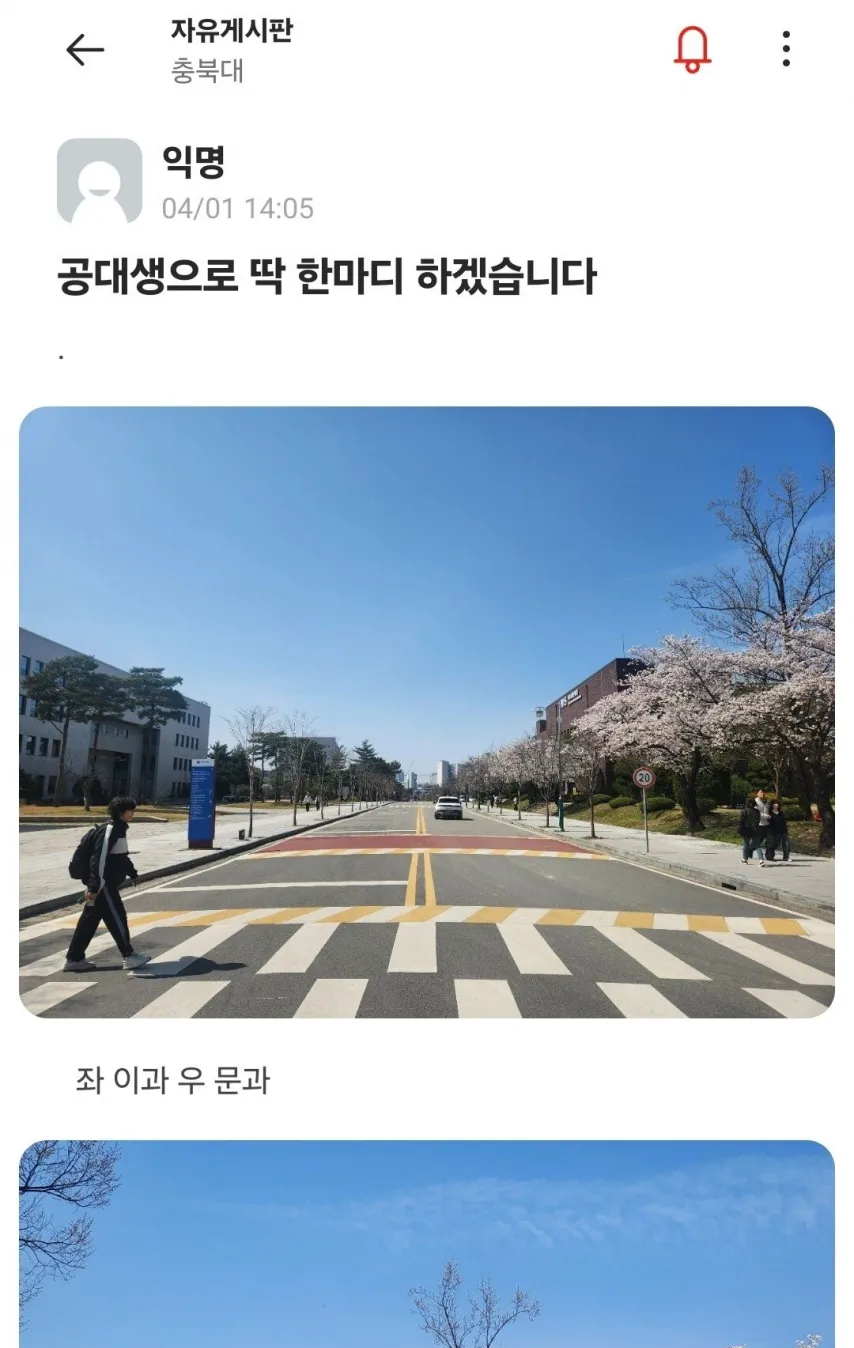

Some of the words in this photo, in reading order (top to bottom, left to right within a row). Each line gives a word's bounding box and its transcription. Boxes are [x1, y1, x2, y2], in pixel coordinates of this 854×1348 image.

[171, 18, 294, 44] 자유게시판
[171, 58, 243, 84] 충북대
[163, 145, 225, 180] 익명
[162, 198, 233, 220] 04/01
[245, 197, 314, 219] 14:05
[57, 257, 239, 296] 공대생으로
[250, 257, 286, 295] 딱
[296, 257, 403, 295] 한마디
[416, 257, 598, 295] 하겠습니다
[639, 773, 650, 782] 20
[76, 1066, 104, 1095] 좌
[114, 1066, 169, 1095] 이과
[178, 1067, 205, 1095] 우
[214, 1066, 270, 1095] 문과
